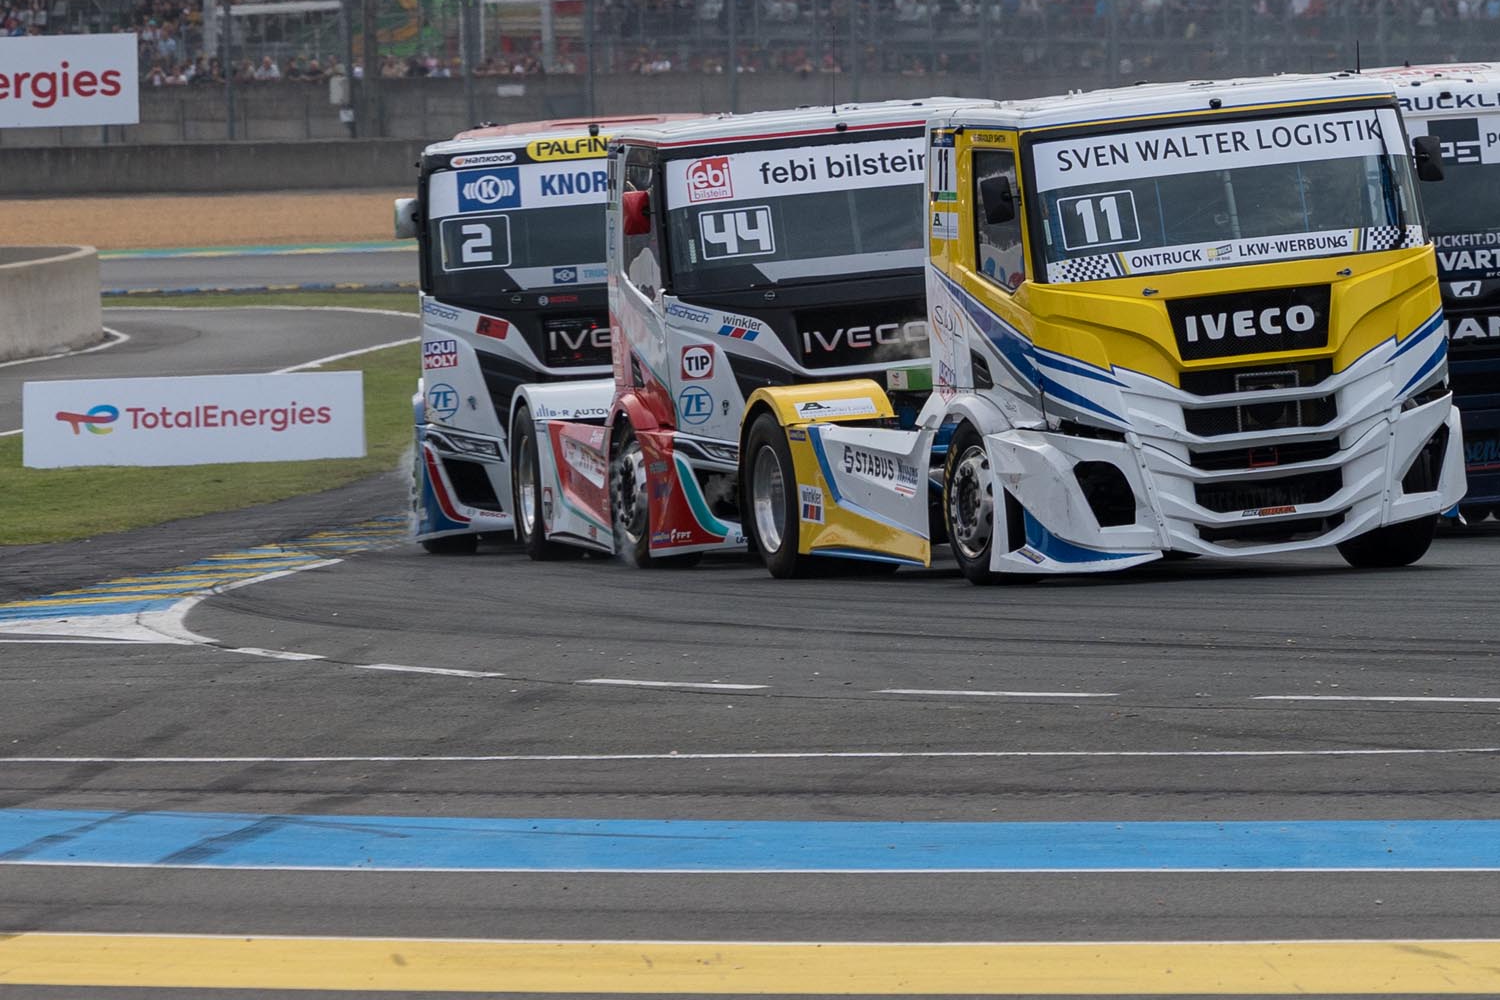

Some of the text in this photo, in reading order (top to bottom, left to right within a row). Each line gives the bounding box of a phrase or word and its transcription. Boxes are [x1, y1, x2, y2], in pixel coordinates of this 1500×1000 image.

[1057, 118, 1383, 172] SVEN WALTER LOGISTIK
[687, 160, 729, 189] febi
[758, 157, 817, 185] febi
[693, 189, 729, 200] bilstein
[702, 210, 772, 254] 44
[1075, 196, 1123, 244] 11
[462, 223, 493, 264] 2
[1131, 249, 1203, 269] ONTRUCK
[1238, 235, 1349, 257] LKW-WERBUNG
[722, 315, 763, 331] winkler
[1185, 304, 1315, 342] IVECO
[685, 355, 711, 372] TIP
[126, 401, 332, 432] TotalEnergies
[681, 394, 710, 417] ZF
[855, 452, 895, 481] STABUS
